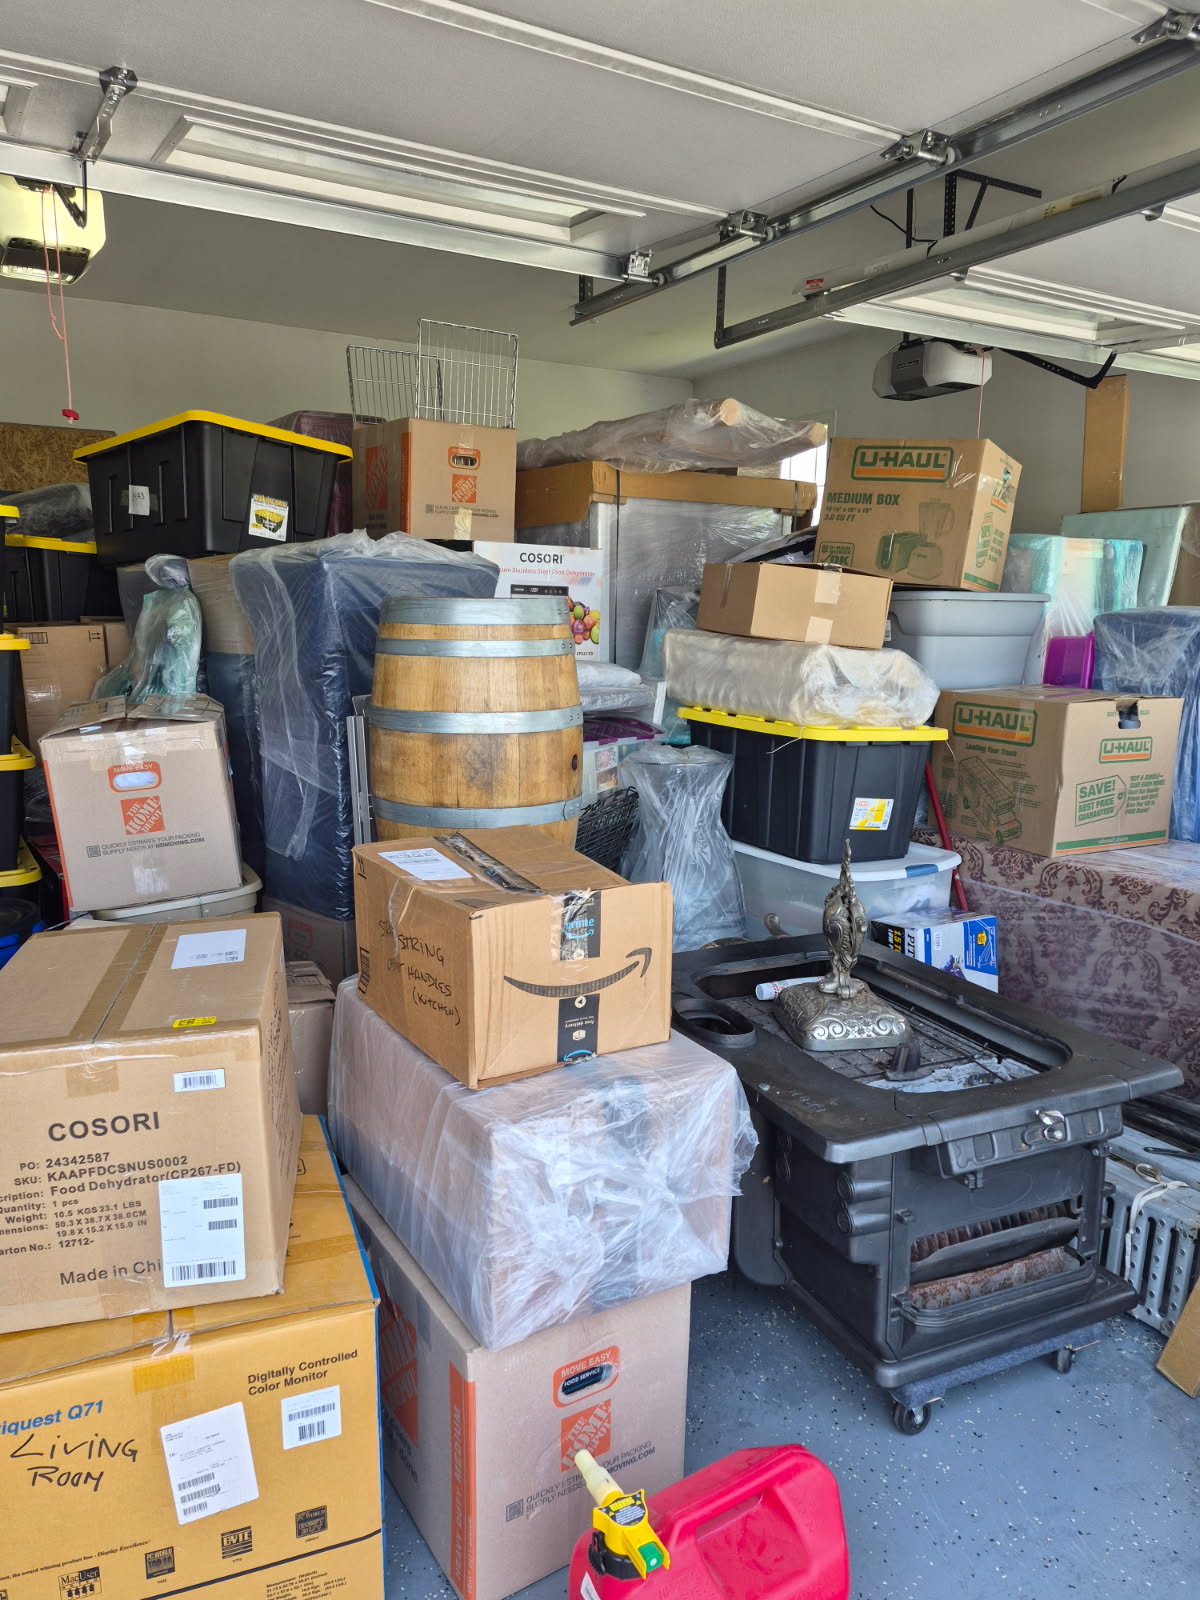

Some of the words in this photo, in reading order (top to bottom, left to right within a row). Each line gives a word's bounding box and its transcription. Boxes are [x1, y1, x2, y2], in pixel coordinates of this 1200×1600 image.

[859, 451, 947, 469] U-HAUL
[826, 491, 873, 505] MEDIUM
[876, 494, 901, 506] BOX
[519, 552, 563, 565] COSORI
[958, 707, 1031, 732] U-HAUL
[1103, 741, 1150, 755] U-HAUL
[1079, 779, 1116, 799] SAVE!
[125, 796, 161, 835] HOME
[126, 801, 143, 817] THE
[1078, 801, 1095, 813] BEST
[101, 842, 127, 850] QUICKLY
[157, 835, 174, 843] YOUR
[175, 832, 201, 840] PACKING
[102, 848, 126, 856] SUPPLY
[126, 845, 147, 853] NEEDS
[564, 918, 595, 932] prime
[908, 933, 916, 959] PIT
[48, 1111, 160, 1142] COSORI
[14, 1176, 42, 1186] SKU:
[47, 1155, 188, 1183] KAAPFDCSNUS0002
[20, 1161, 40, 1171] PO:
[45, 1152, 110, 1169] 24342587
[0, 1189, 44, 1202] cription:
[51, 1181, 86, 1196] Food
[5, 1212, 47, 1225] Weight:
[54, 1209, 73, 1219] 10.5
[77, 1206, 98, 1216] KGS
[99, 1203, 118, 1213] 23.1
[122, 1200, 142, 1210] LBS
[62, 1198, 79, 1208] pcs
[0, 1223, 49, 1236] mensions:
[55, 1219, 74, 1229] 50.3
[76, 1218, 82, 1226] X
[84, 1215, 103, 1225] 38.7
[56, 1229, 76, 1238] 19.8
[86, 1225, 105, 1234] 15.2
[115, 1221, 134, 1230] 15.0
[137, 1219, 148, 1227] IN
[0, 1245, 27, 1256] arton
[29, 1242, 52, 1252] No.:
[58, 1237, 95, 1249] 12712-
[60, 1268, 109, 1286] Made
[113, 1265, 128, 1278] in
[133, 1260, 161, 1276] Chi
[247, 1366, 296, 1385] Digitally
[298, 1348, 359, 1372] Controlled
[560, 1361, 587, 1379] MOVE
[588, 1350, 612, 1367] EASY
[248, 1381, 281, 1396] Color
[284, 1369, 328, 1388] Monitor
[564, 1376, 579, 1388] FOOD
[580, 1367, 601, 1381] SERVICE
[0, 1409, 63, 1437] iquest
[67, 1400, 104, 1420] Q71
[567, 1415, 588, 1442] THE
[453, 1404, 463, 1484] MEDIUM
[26, 1465, 105, 1493] ROOM
[526, 1480, 560, 1504] QUICKLY
[561, 1474, 583, 1489] ESTIM
[601, 1453, 621, 1469] OUR
[621, 1440, 652, 1460] PACKING
[526, 1494, 556, 1513] SUPPLY
[557, 1481, 584, 1498] NEEDS
[606, 1446, 656, 1474] MOVING.COM
[454, 1486, 463, 1528] DUTY
[223, 1530, 251, 1547] BYTE
[97, 1548, 118, 1557] Display
[454, 1532, 463, 1581] HEAVY
[60, 1568, 99, 1586] MacUser
